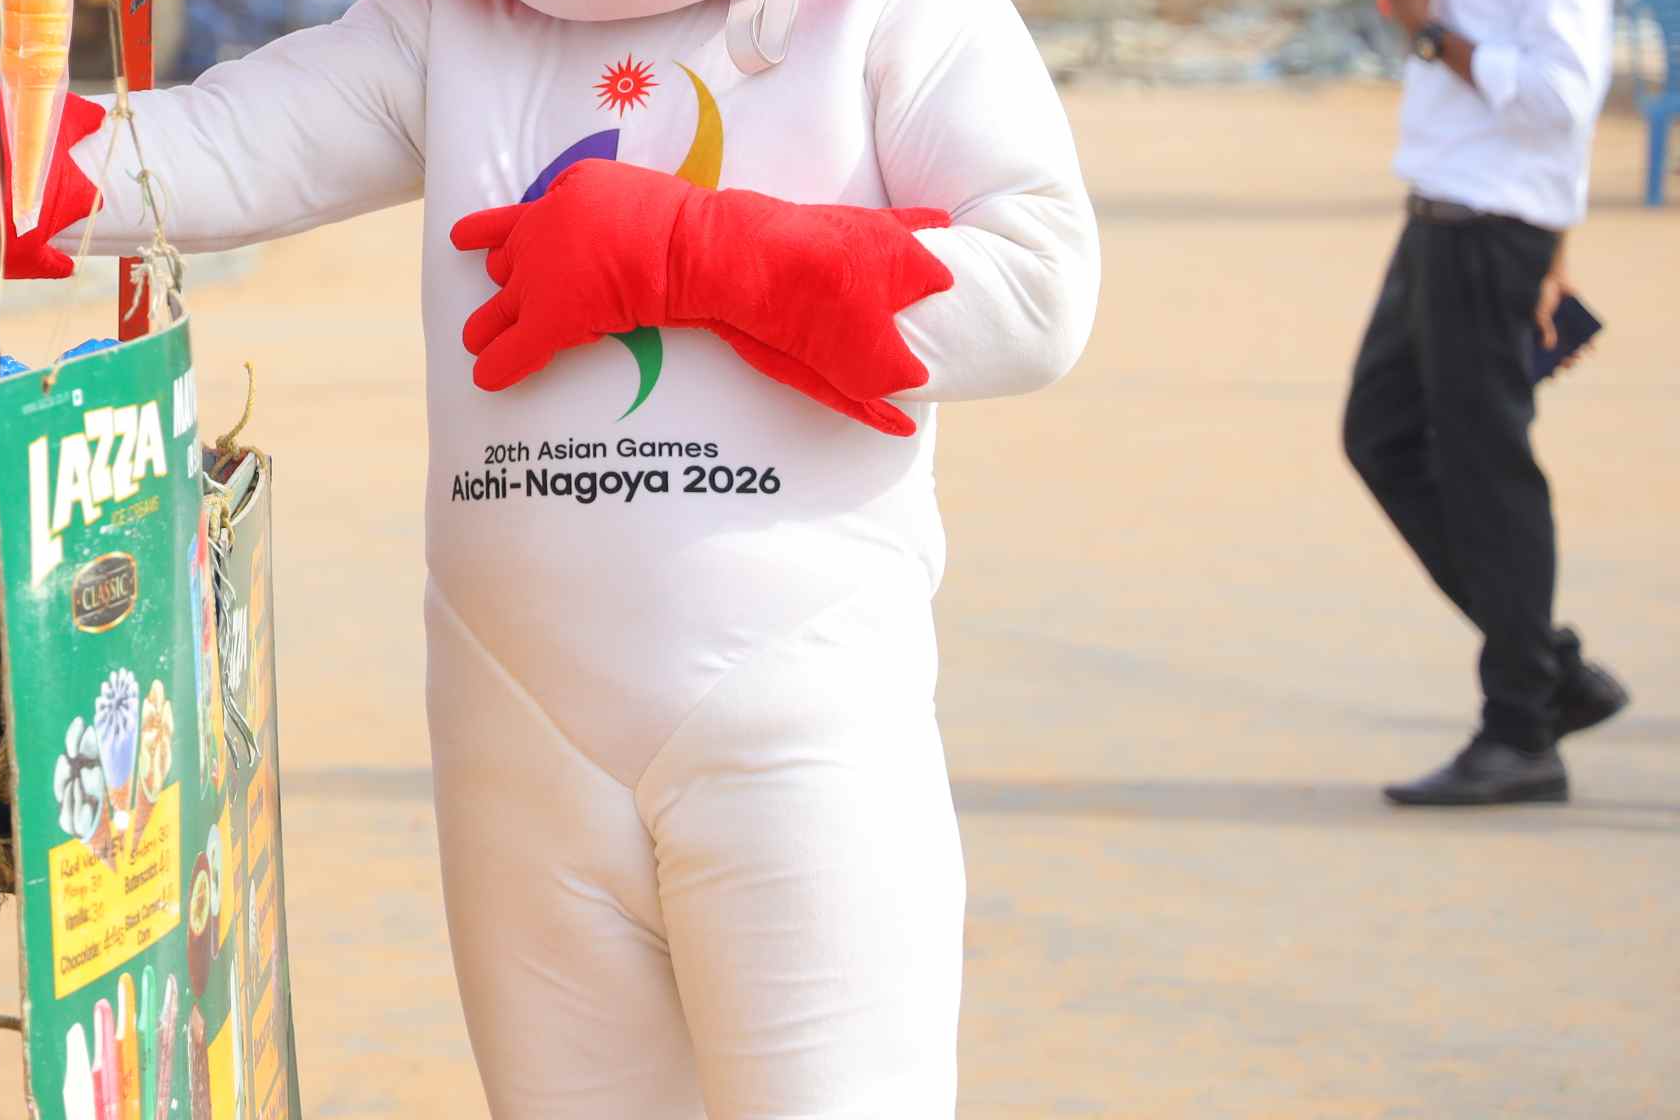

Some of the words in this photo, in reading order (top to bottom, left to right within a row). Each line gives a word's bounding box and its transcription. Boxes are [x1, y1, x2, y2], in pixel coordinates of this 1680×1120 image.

[484, 441, 530, 465] 20th
[537, 438, 607, 461] Asian
[616, 437, 719, 459] Games
[28, 400, 168, 588] LAZZA
[451, 467, 670, 504] Aichi-Nagoya
[682, 465, 781, 495] 2026
[81, 573, 130, 611] CLASSIC
